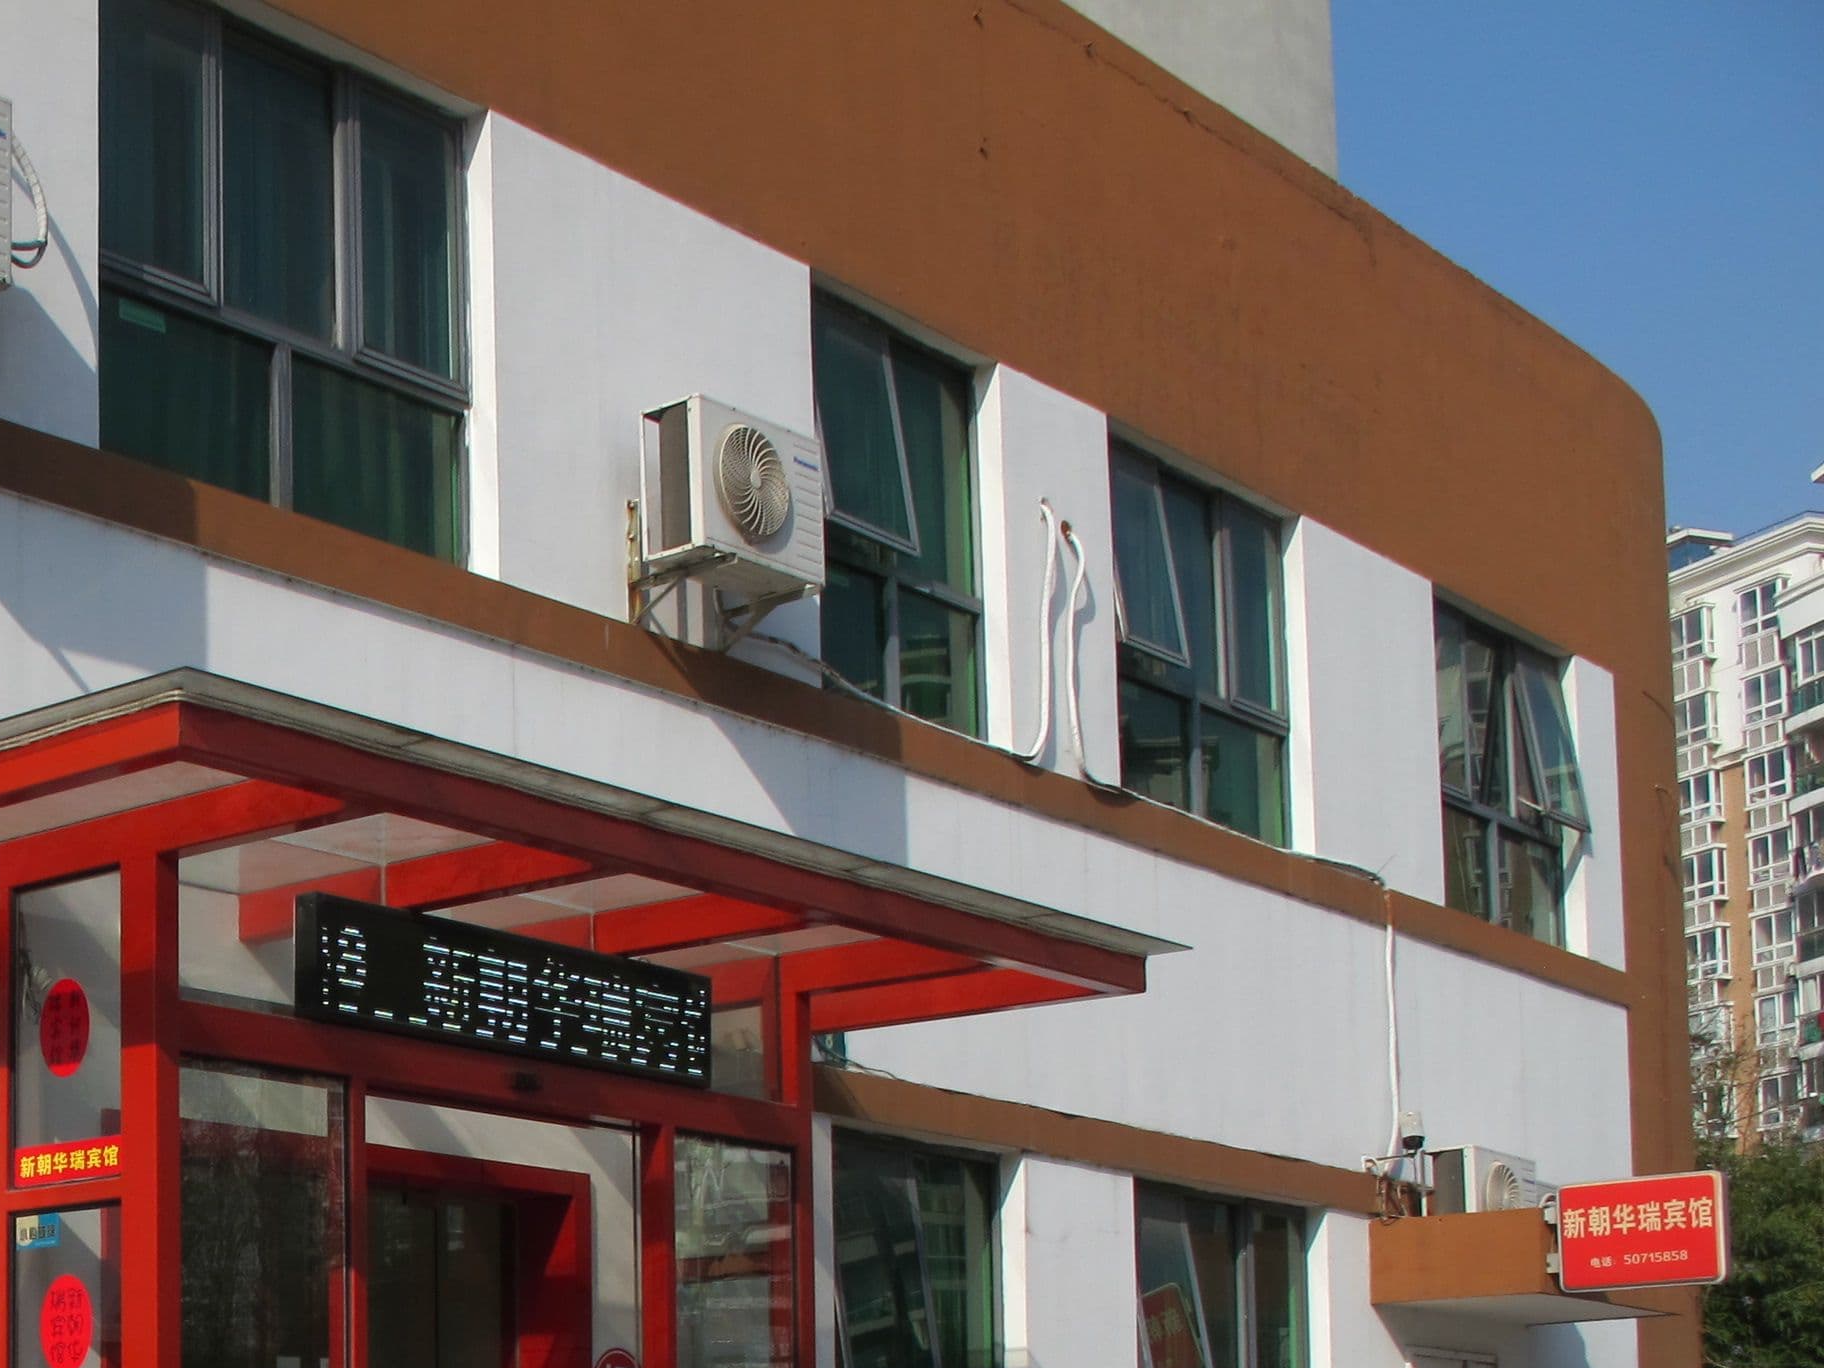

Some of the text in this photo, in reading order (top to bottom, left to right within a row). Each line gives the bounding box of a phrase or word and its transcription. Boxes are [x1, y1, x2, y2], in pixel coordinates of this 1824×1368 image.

[19, 1145, 120, 1179] 新朝华瑞宾馆
[1562, 1196, 1713, 1239] 新朝华瑞宾馆
[1623, 1250, 1689, 1265] 50715858
